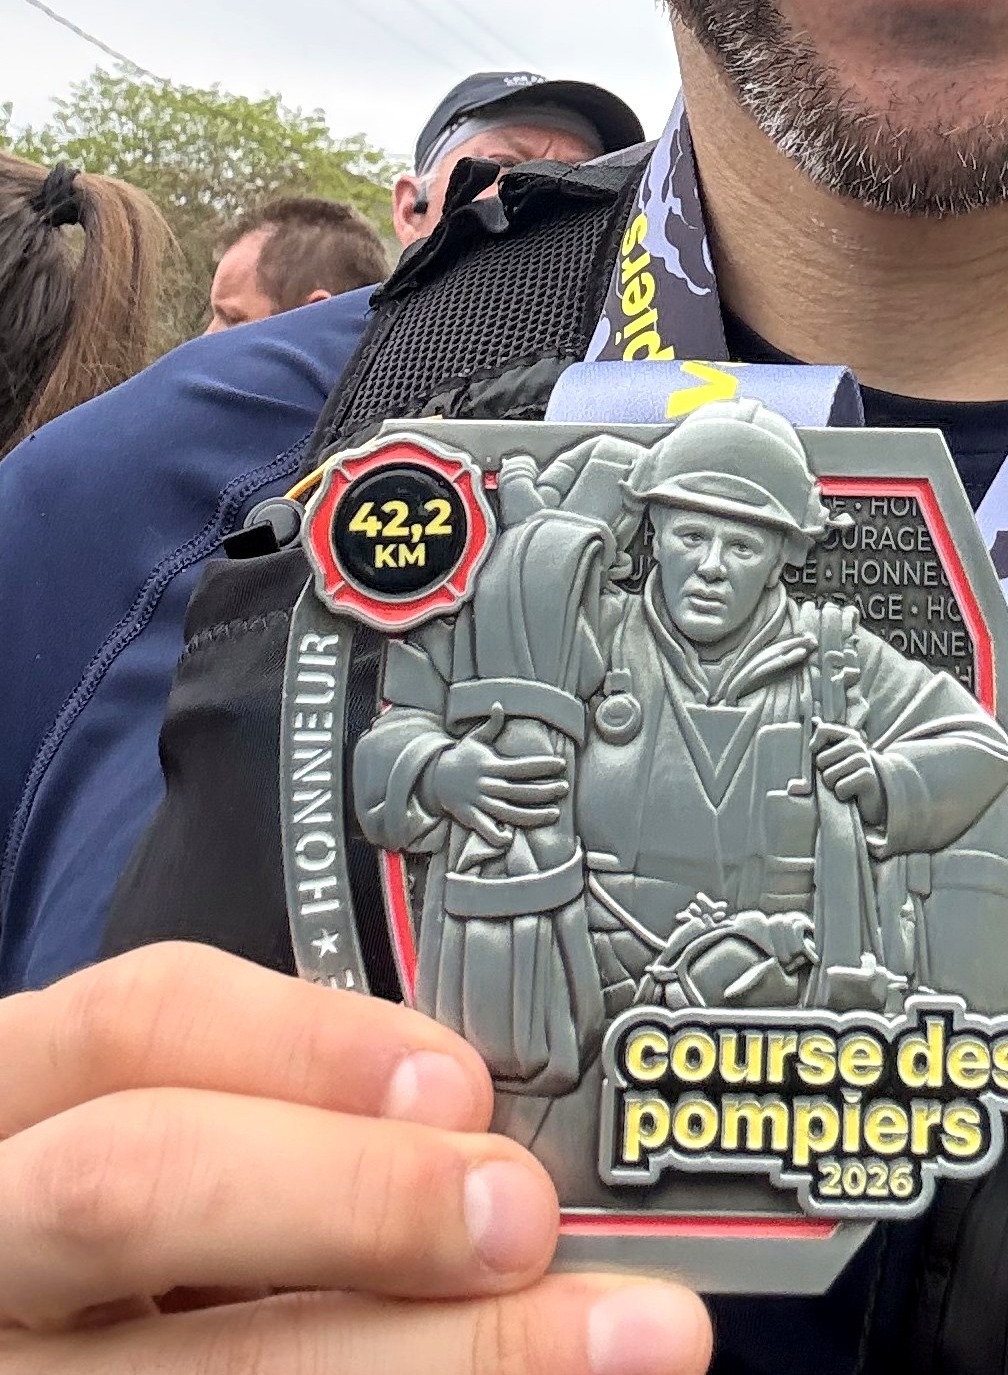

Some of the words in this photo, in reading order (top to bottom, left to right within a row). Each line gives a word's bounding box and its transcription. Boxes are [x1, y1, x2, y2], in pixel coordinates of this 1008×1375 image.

[348, 498, 453, 543] 42,2
[374, 543, 427, 569] KM
[292, 633, 340, 916] HONNEUR
[624, 1025, 884, 1086] course
[622, 1088, 983, 1166] pompiers
[817, 1159, 915, 1198] 2026
